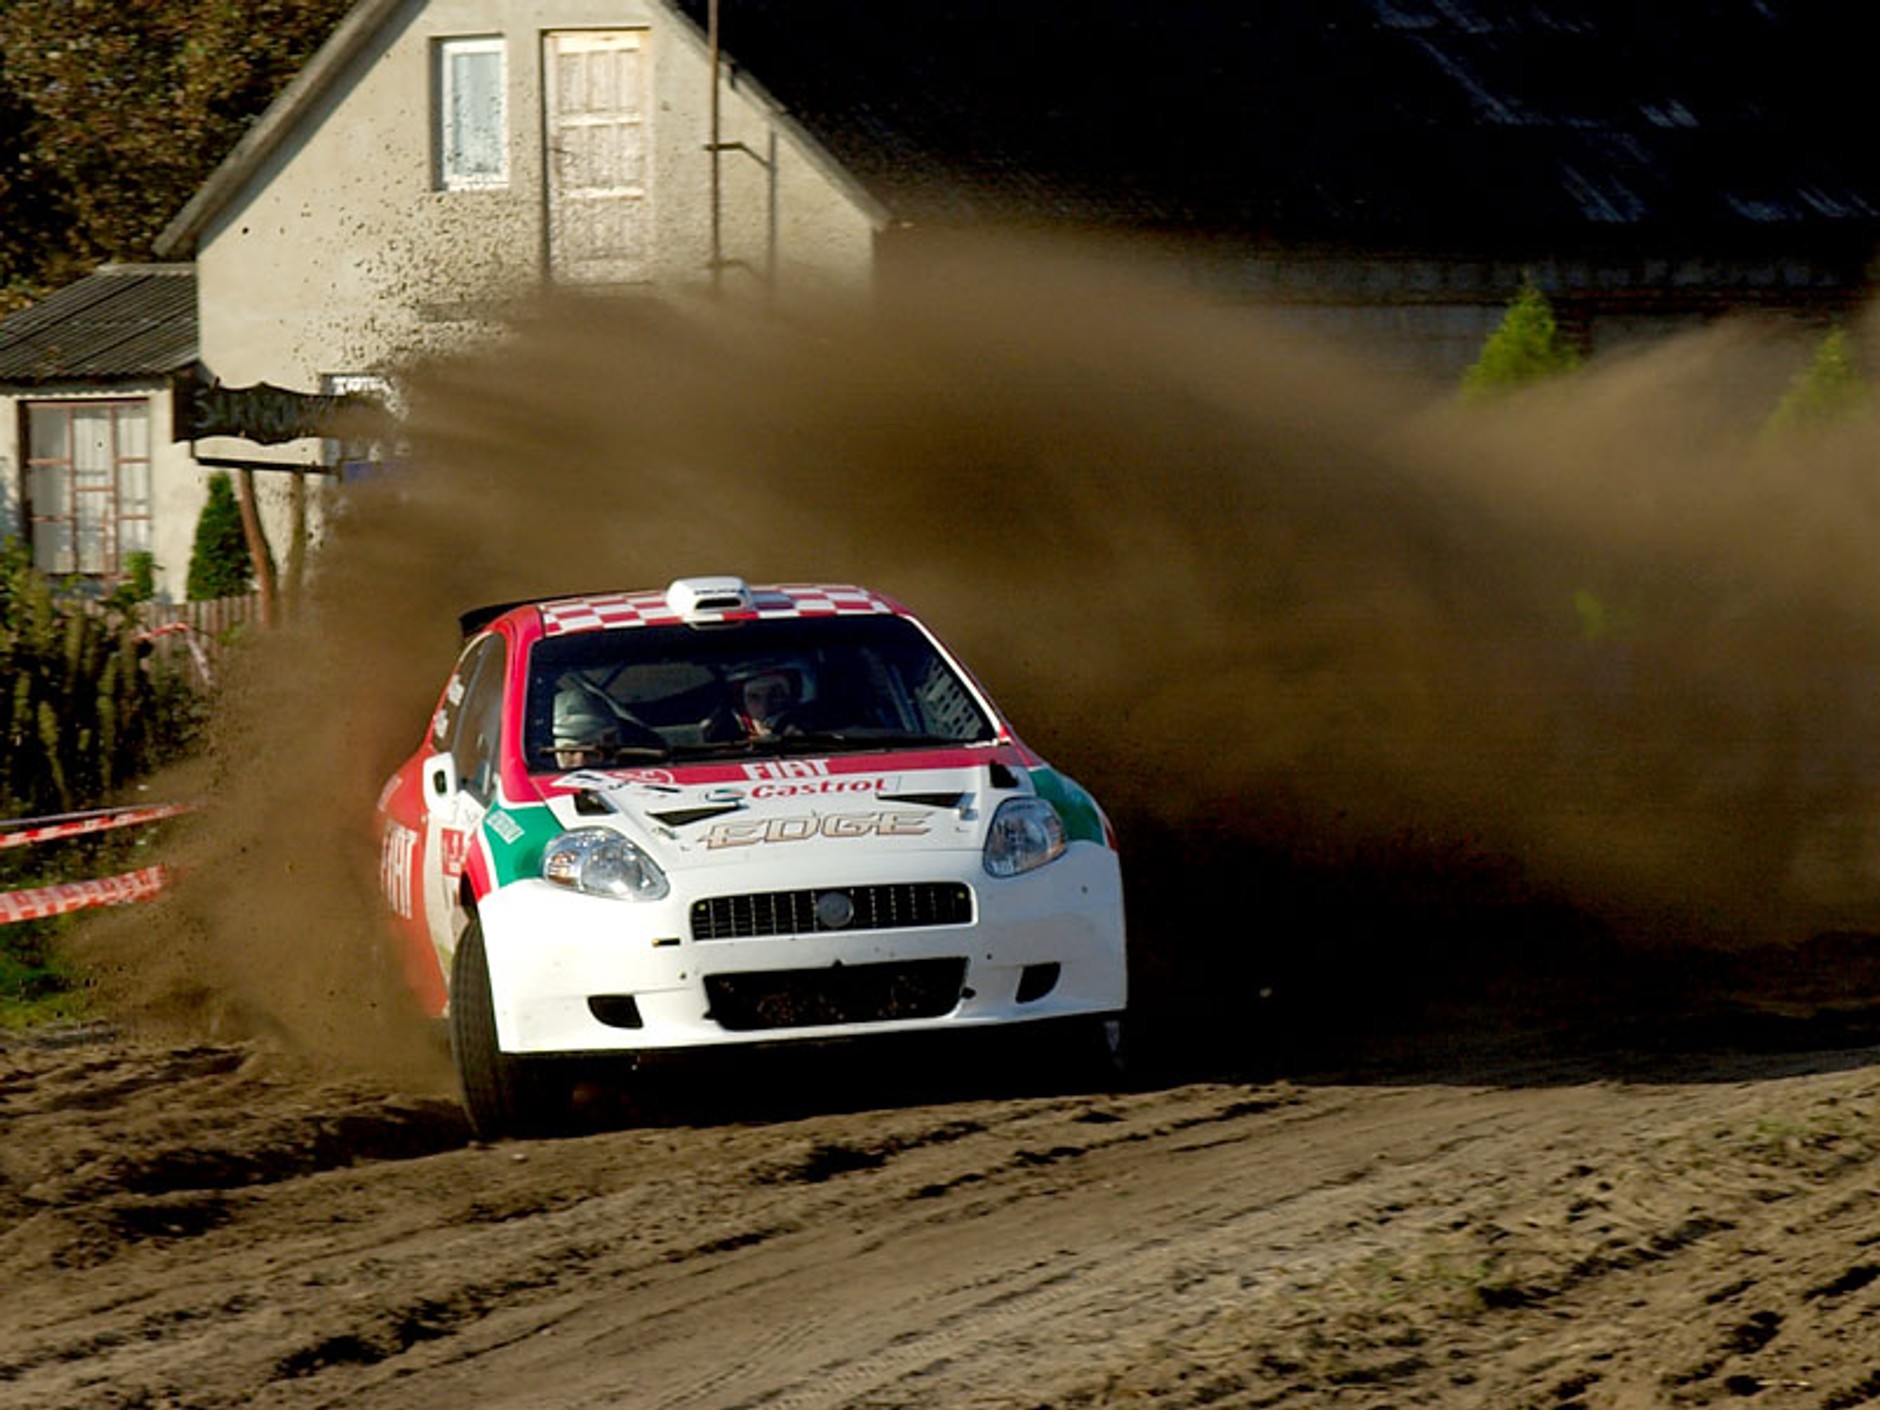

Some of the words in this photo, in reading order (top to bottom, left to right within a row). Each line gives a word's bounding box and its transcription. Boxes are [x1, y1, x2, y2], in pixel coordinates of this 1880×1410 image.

[742, 758, 832, 781] FIAT
[751, 777, 887, 799] Castrol
[698, 811, 934, 850] EDGE
